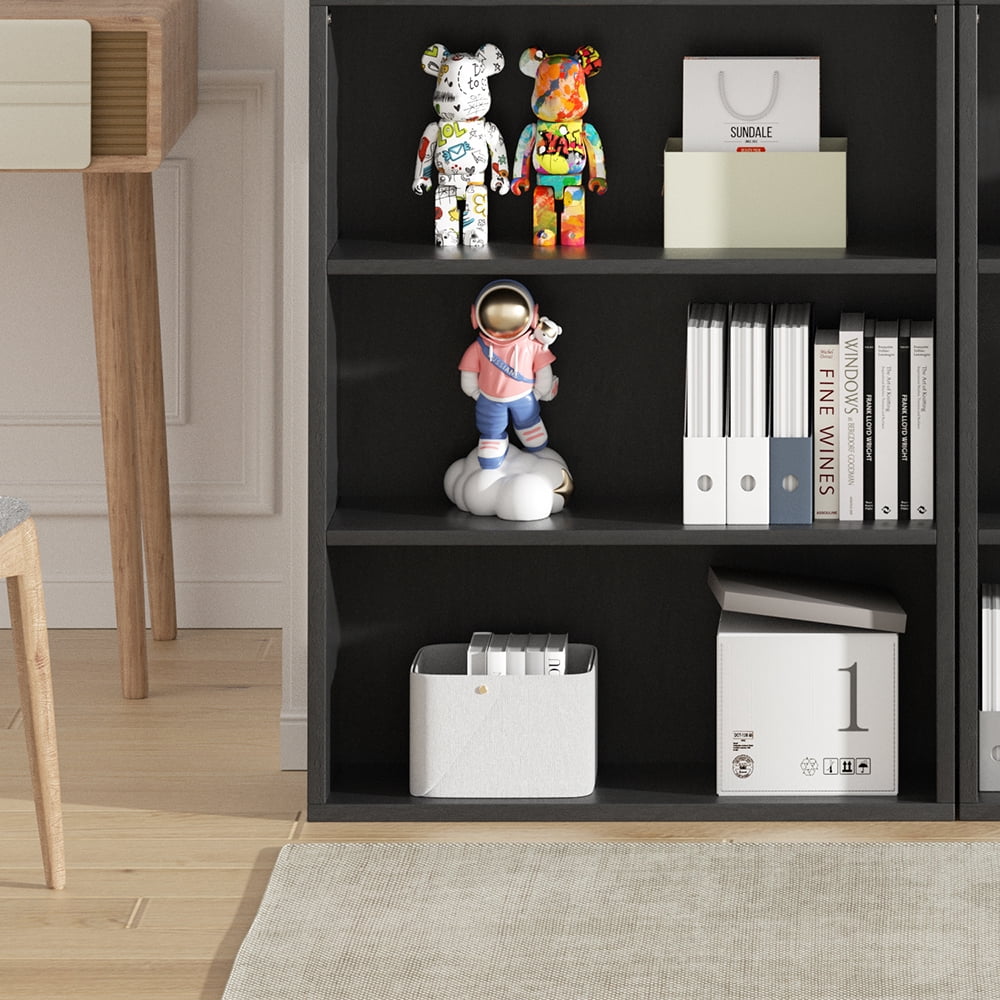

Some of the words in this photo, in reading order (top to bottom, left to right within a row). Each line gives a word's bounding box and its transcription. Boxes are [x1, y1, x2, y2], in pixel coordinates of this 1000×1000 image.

[730, 126, 773, 138] SUNDALE
[819, 369, 835, 415] FINE
[844, 338, 858, 415] WINDOWS
[819, 425, 835, 495] WINES
[847, 423, 855, 453] BERGDORF
[847, 454, 855, 485] GOODMAN
[838, 662, 869, 732] 1
